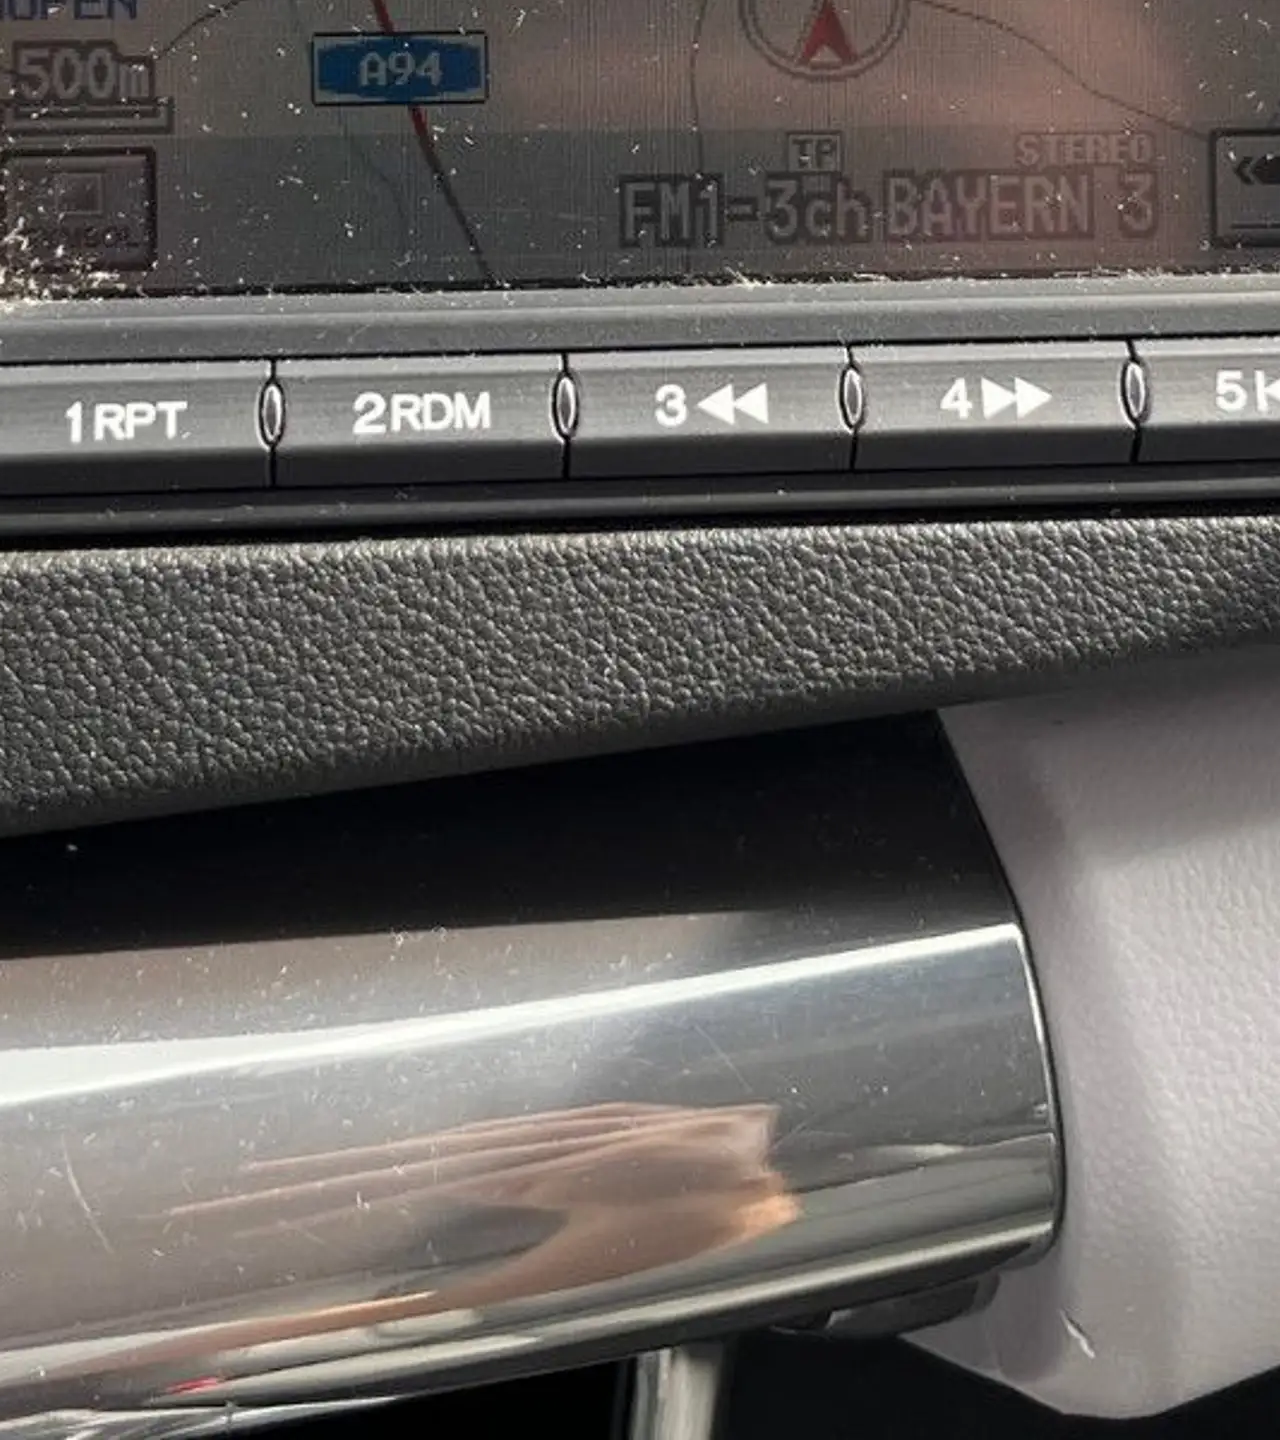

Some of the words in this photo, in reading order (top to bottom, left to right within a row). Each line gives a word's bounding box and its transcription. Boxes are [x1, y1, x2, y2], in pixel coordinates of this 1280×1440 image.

[20, 47, 150, 100] 500m
[357, 52, 444, 87] A94
[1016, 134, 1153, 166] STEREO
[888, 173, 1090, 239] BAYERN
[1124, 172, 1153, 232] 3
[656, 383, 687, 426] 3
[940, 377, 972, 418] 4
[1214, 371, 1245, 413] 5
